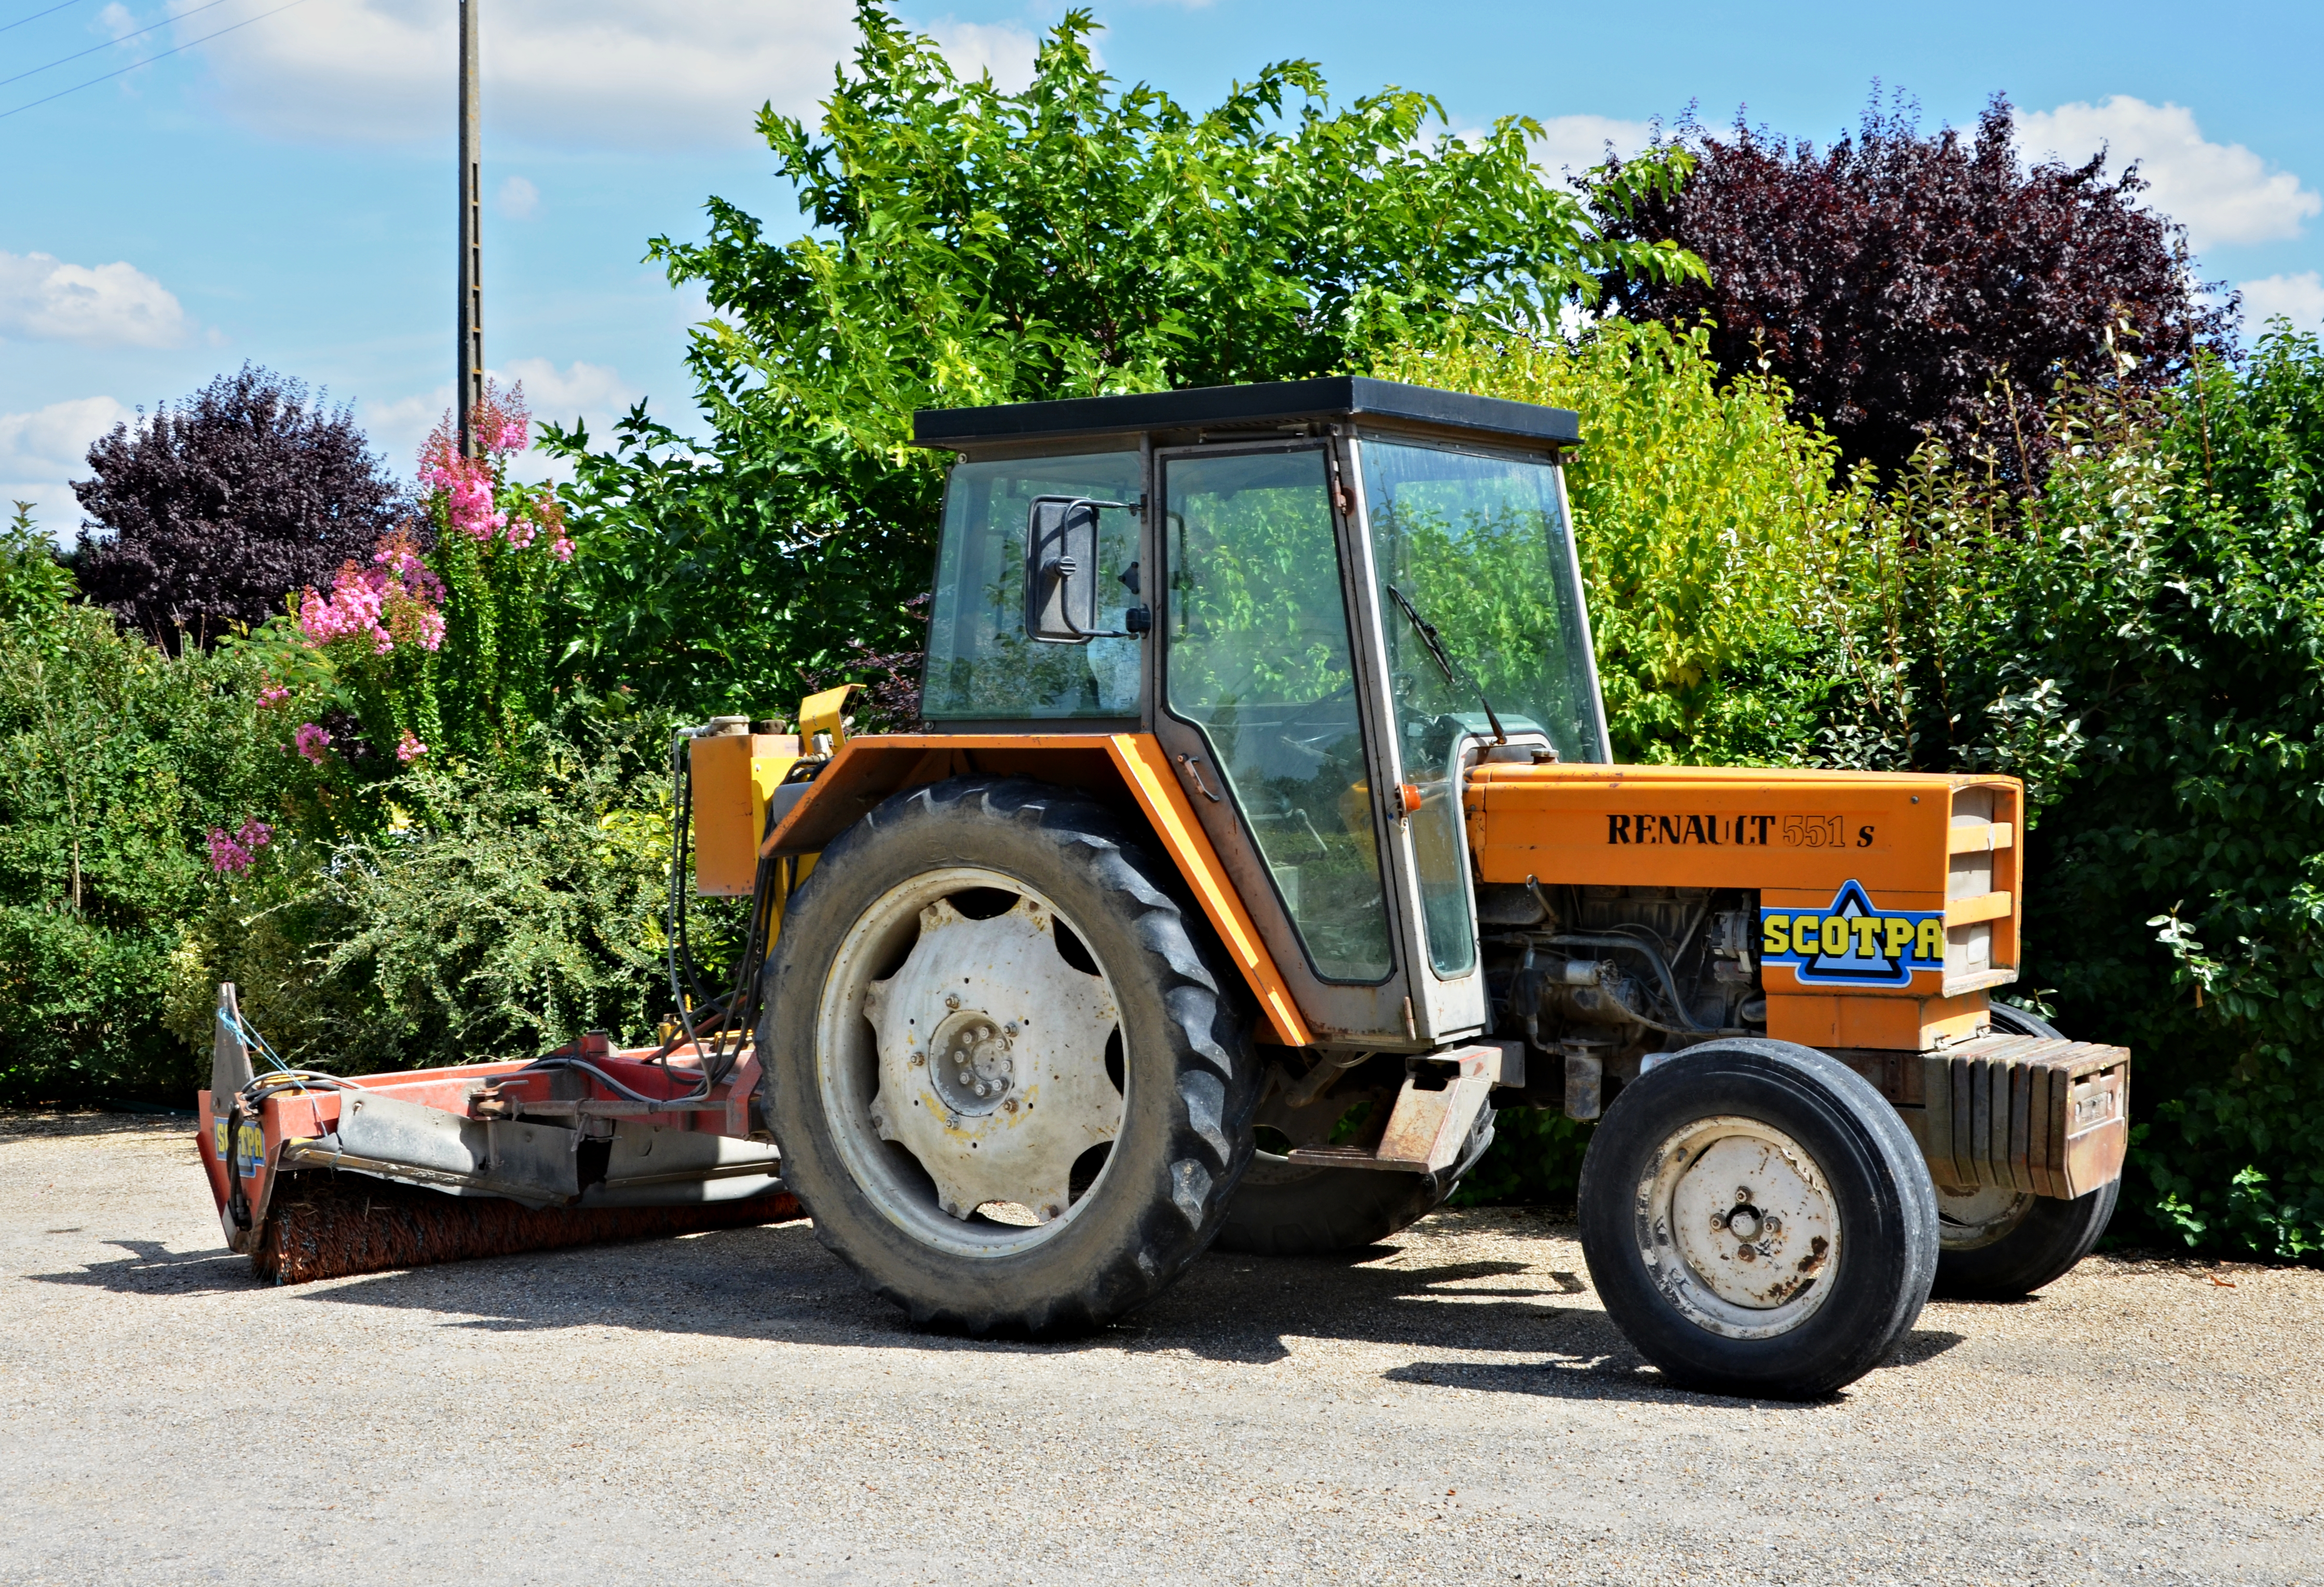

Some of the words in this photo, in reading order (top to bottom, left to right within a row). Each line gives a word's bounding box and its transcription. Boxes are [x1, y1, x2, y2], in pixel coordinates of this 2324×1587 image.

[1606, 814, 1776, 845] RENAULT
[1783, 815, 1846, 847] 551
[1763, 914, 1944, 959] SCOTPA
[216, 1123, 264, 1158] STPA
